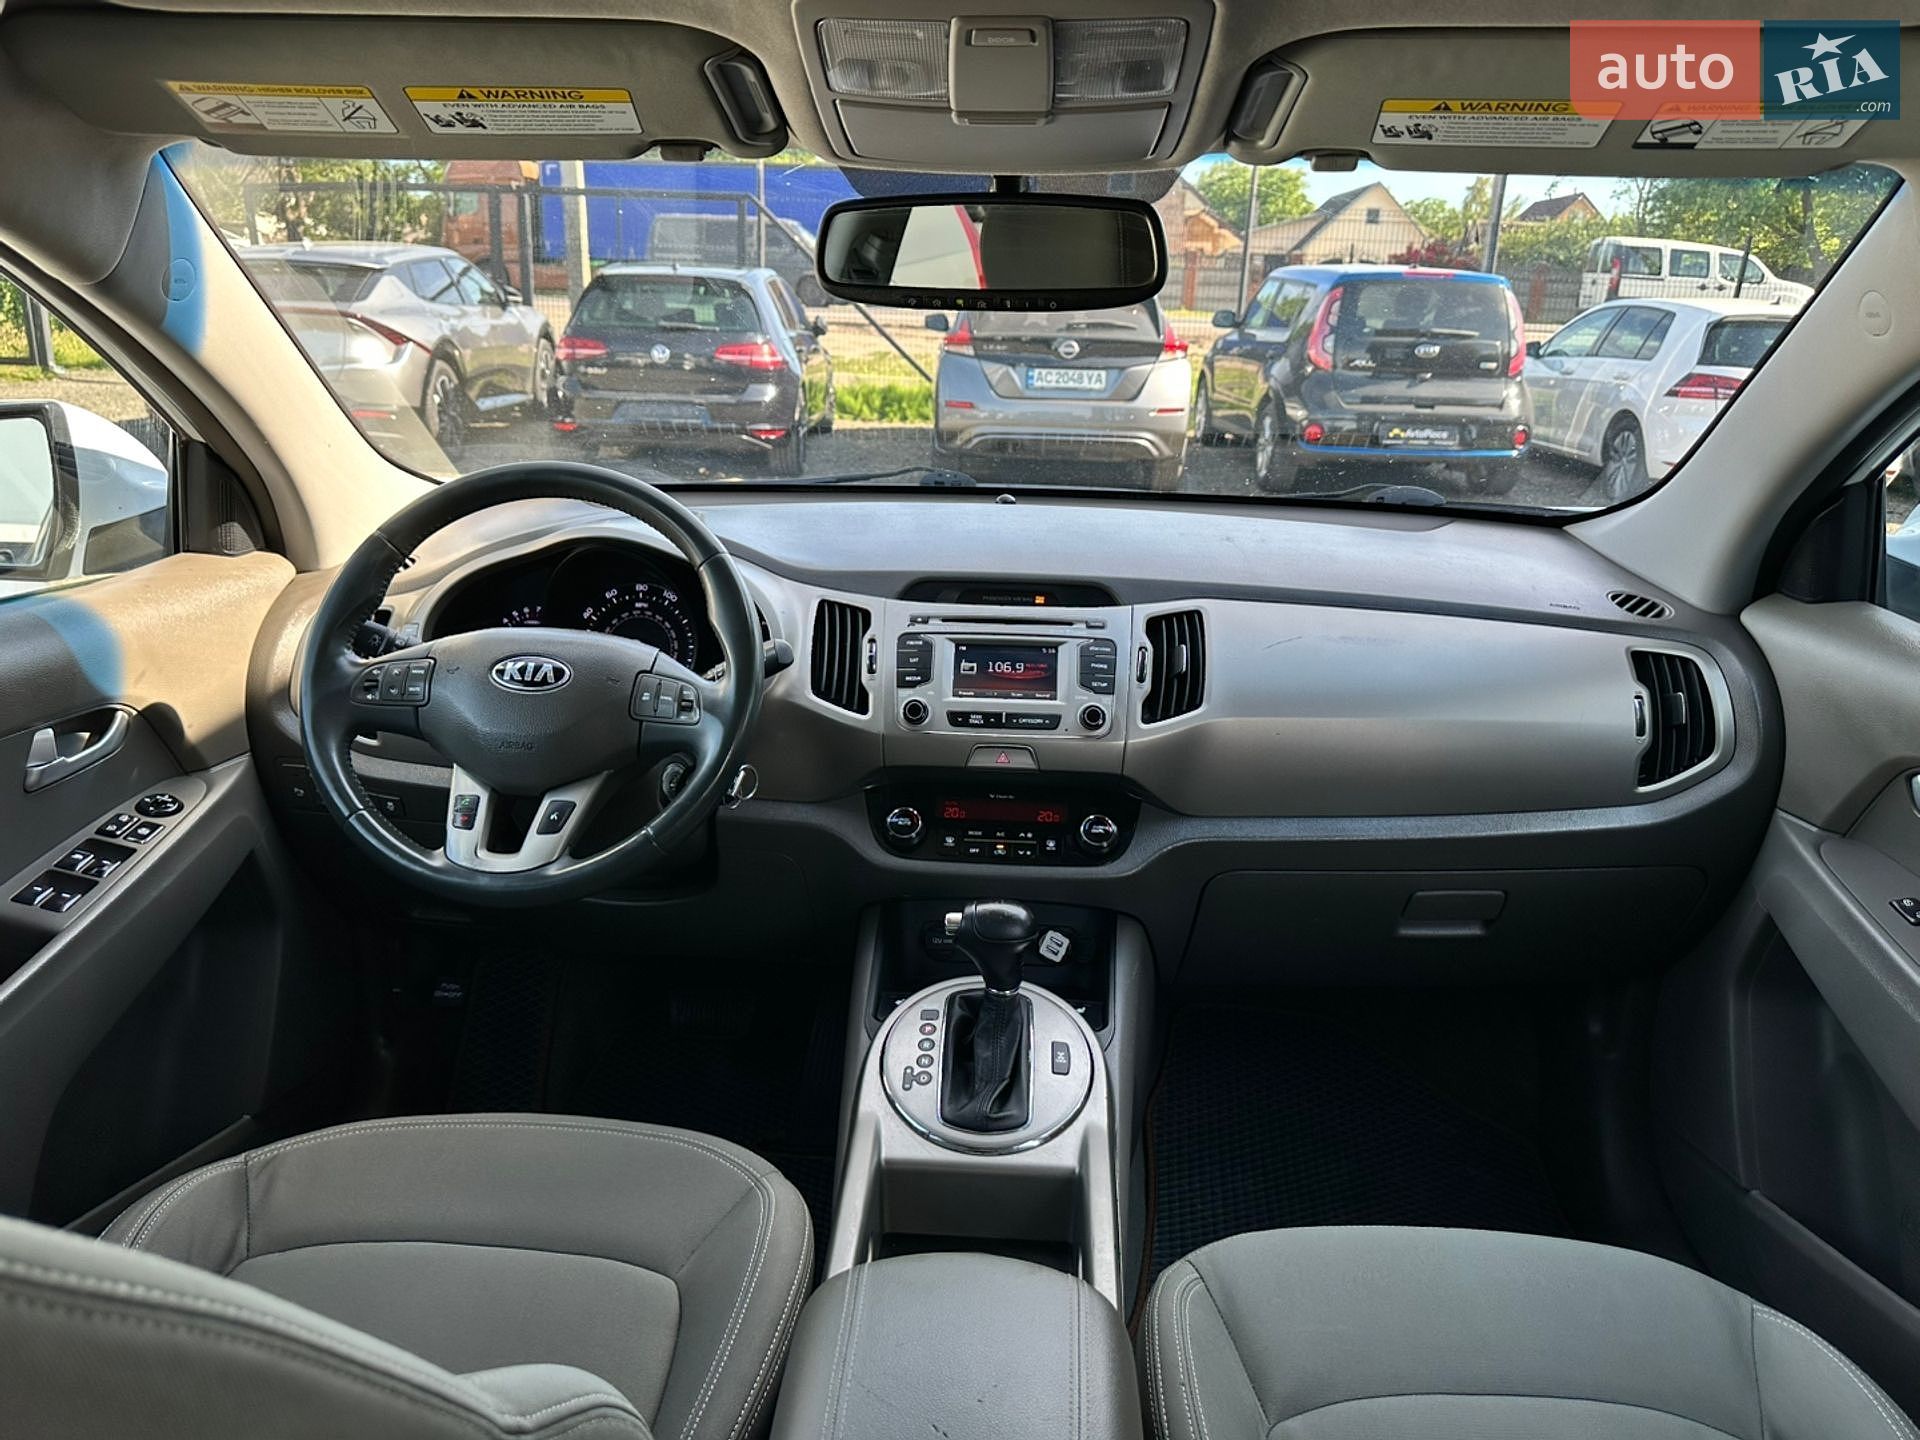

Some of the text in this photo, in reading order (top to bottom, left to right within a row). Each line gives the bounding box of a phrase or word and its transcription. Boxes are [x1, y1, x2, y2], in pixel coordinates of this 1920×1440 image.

[478, 88, 585, 100] WARNING
[1460, 101, 1569, 113] WARNING
[502, 661, 556, 684] KIA
[987, 661, 1025, 674] 106.9
